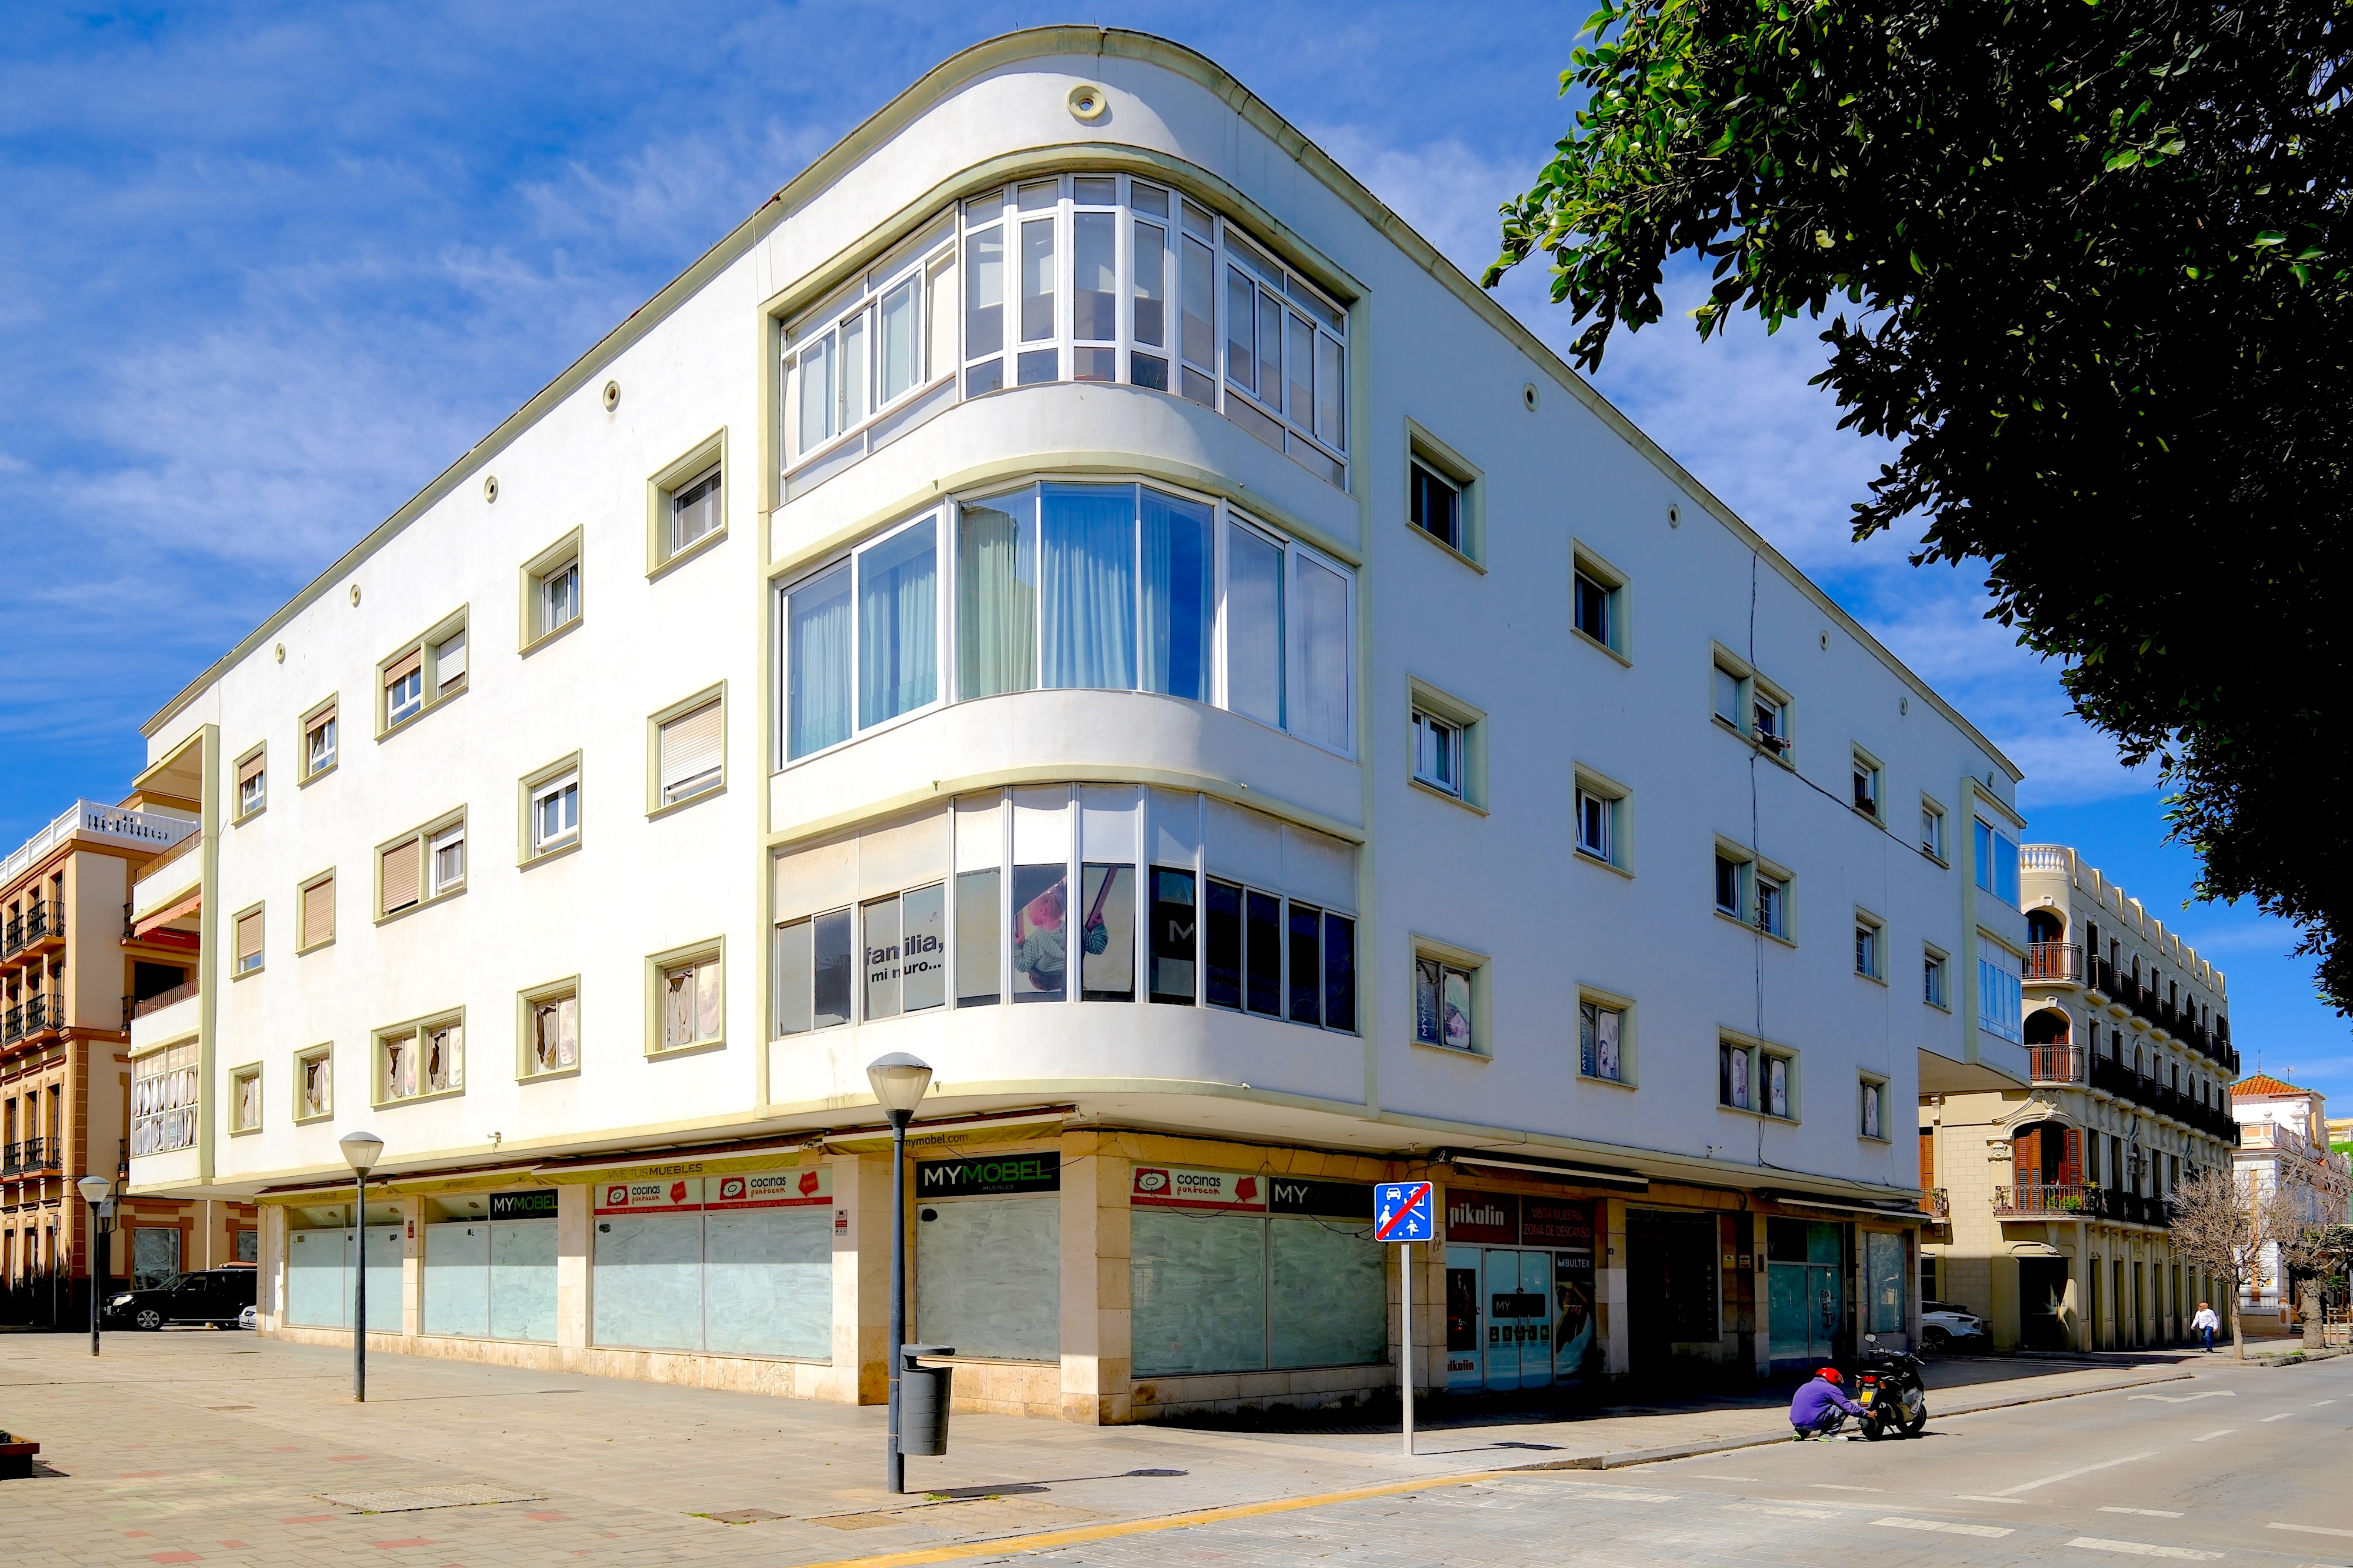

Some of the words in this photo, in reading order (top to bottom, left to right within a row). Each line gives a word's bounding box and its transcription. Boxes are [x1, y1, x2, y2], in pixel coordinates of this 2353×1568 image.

[866, 934, 944, 966] familia,
[871, 968, 888, 983] mi
[904, 1133, 968, 1148] mymobel.com
[608, 1170, 626, 1179] VIVE
[631, 1168, 648, 1177] TUS
[649, 1163, 703, 1176] MUEBLES
[924, 1160, 1052, 1186] MYMOBEL
[751, 1176, 786, 1188] cocinas
[1177, 1175, 1221, 1187] cocinas
[632, 1185, 660, 1195] cocinas
[750, 1187, 786, 1197] puntocom
[1177, 1186, 1220, 1196] puntocom
[494, 1195, 558, 1212] MYMOBEL
[631, 1195, 660, 1205] puntocom
[1449, 1203, 1505, 1228] pikolin
[1531, 1206, 1552, 1220] VISITA
[1553, 1208, 1583, 1221] NUESTRA
[1523, 1223, 1544, 1235] ZONA
[1545, 1225, 1555, 1236] DE
[1556, 1226, 1591, 1238] DESCANSO
[1565, 1259, 1590, 1268] BULTEX
